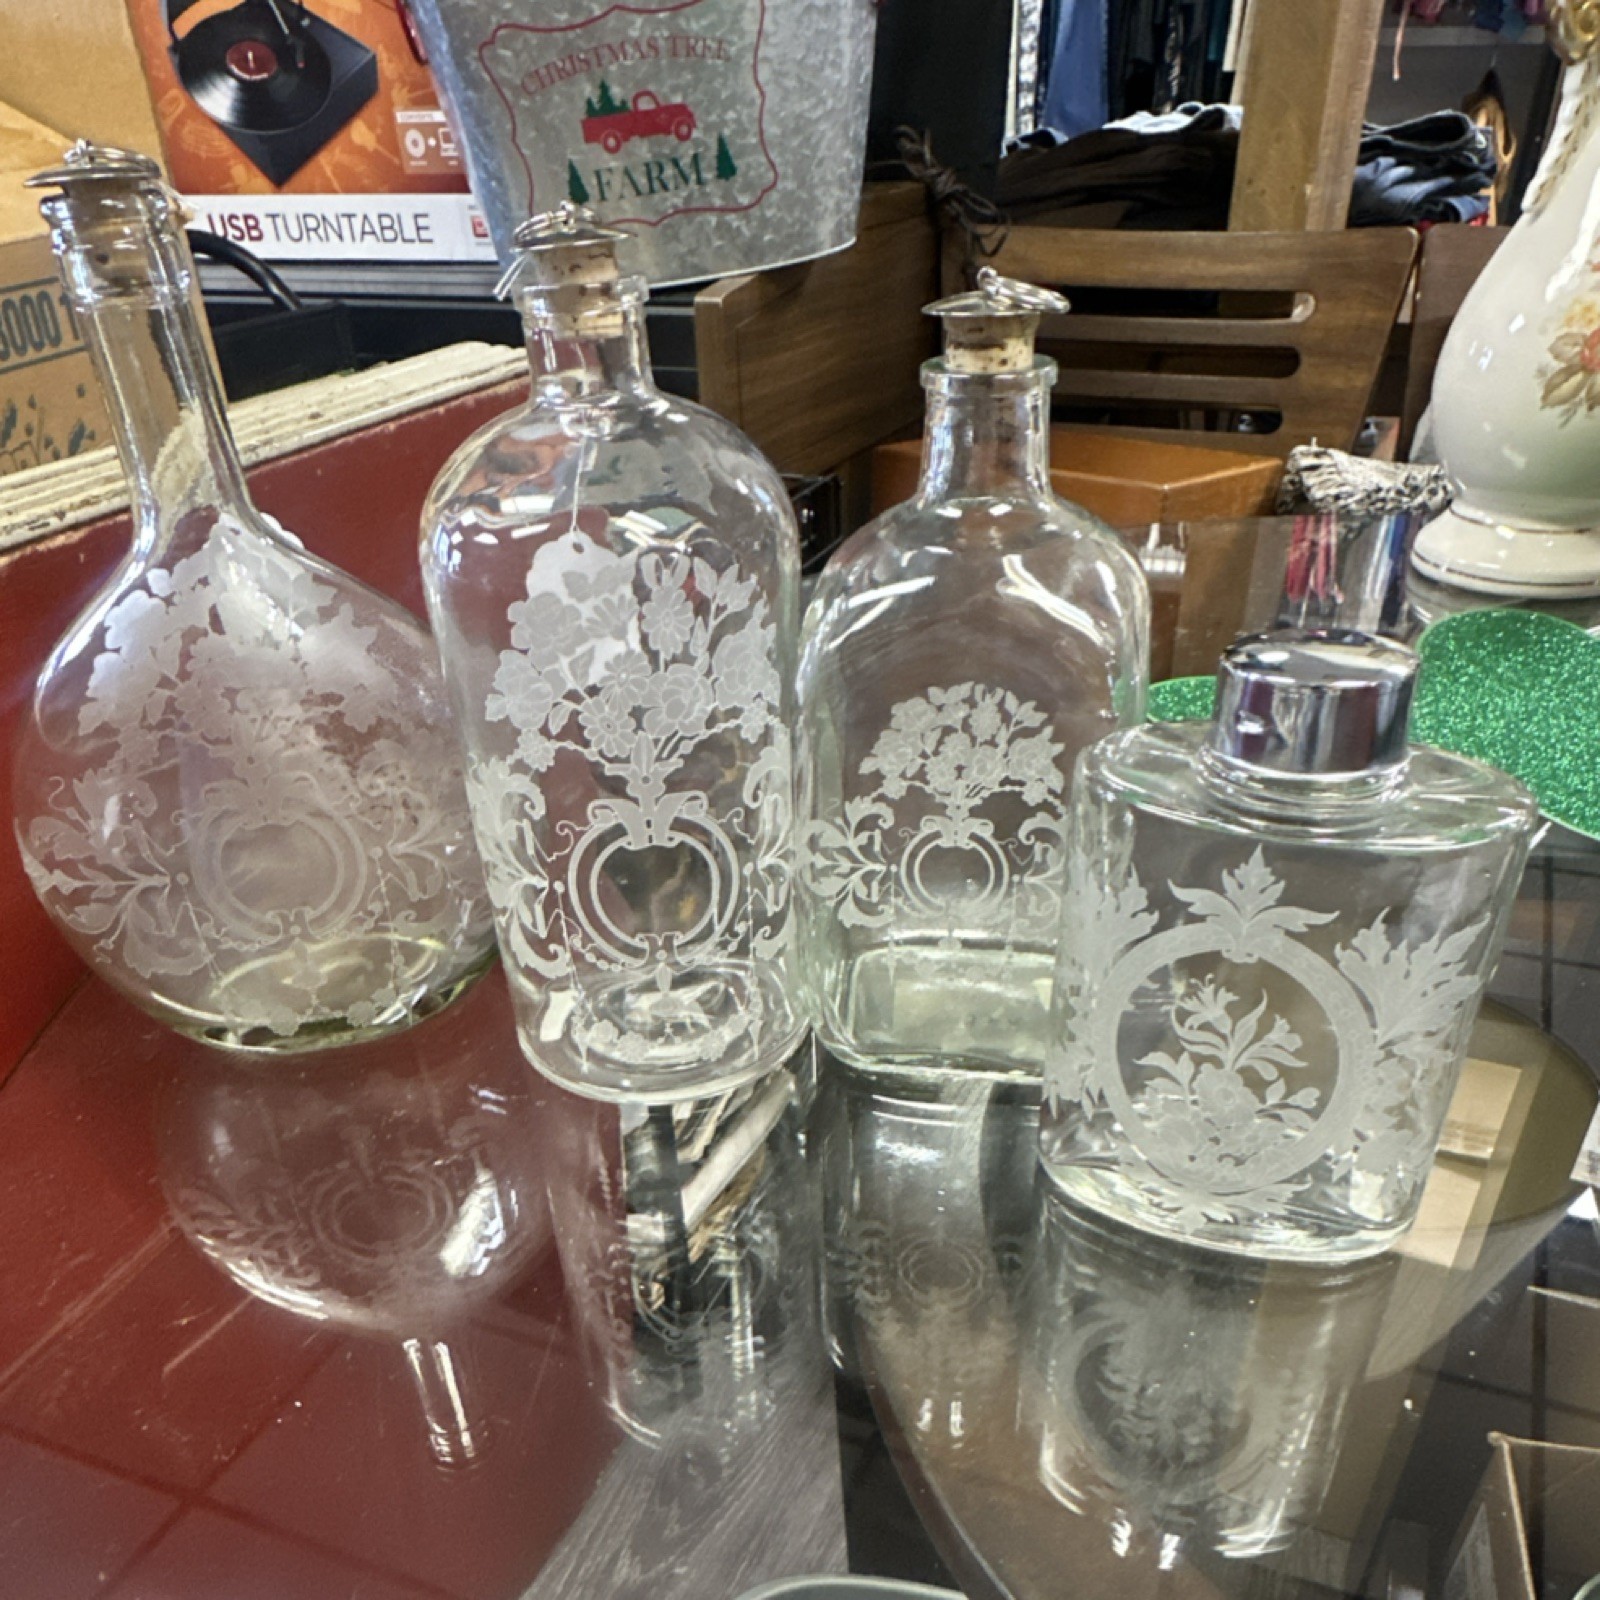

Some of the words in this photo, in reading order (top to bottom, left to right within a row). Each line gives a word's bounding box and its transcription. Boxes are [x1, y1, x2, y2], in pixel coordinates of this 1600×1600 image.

[520, 35, 661, 97] CHRISTMAS
[665, 34, 732, 63] TREE
[593, 152, 705, 201] FARM
[207, 213, 263, 242] USB
[265, 213, 434, 243] TURNTABLE
